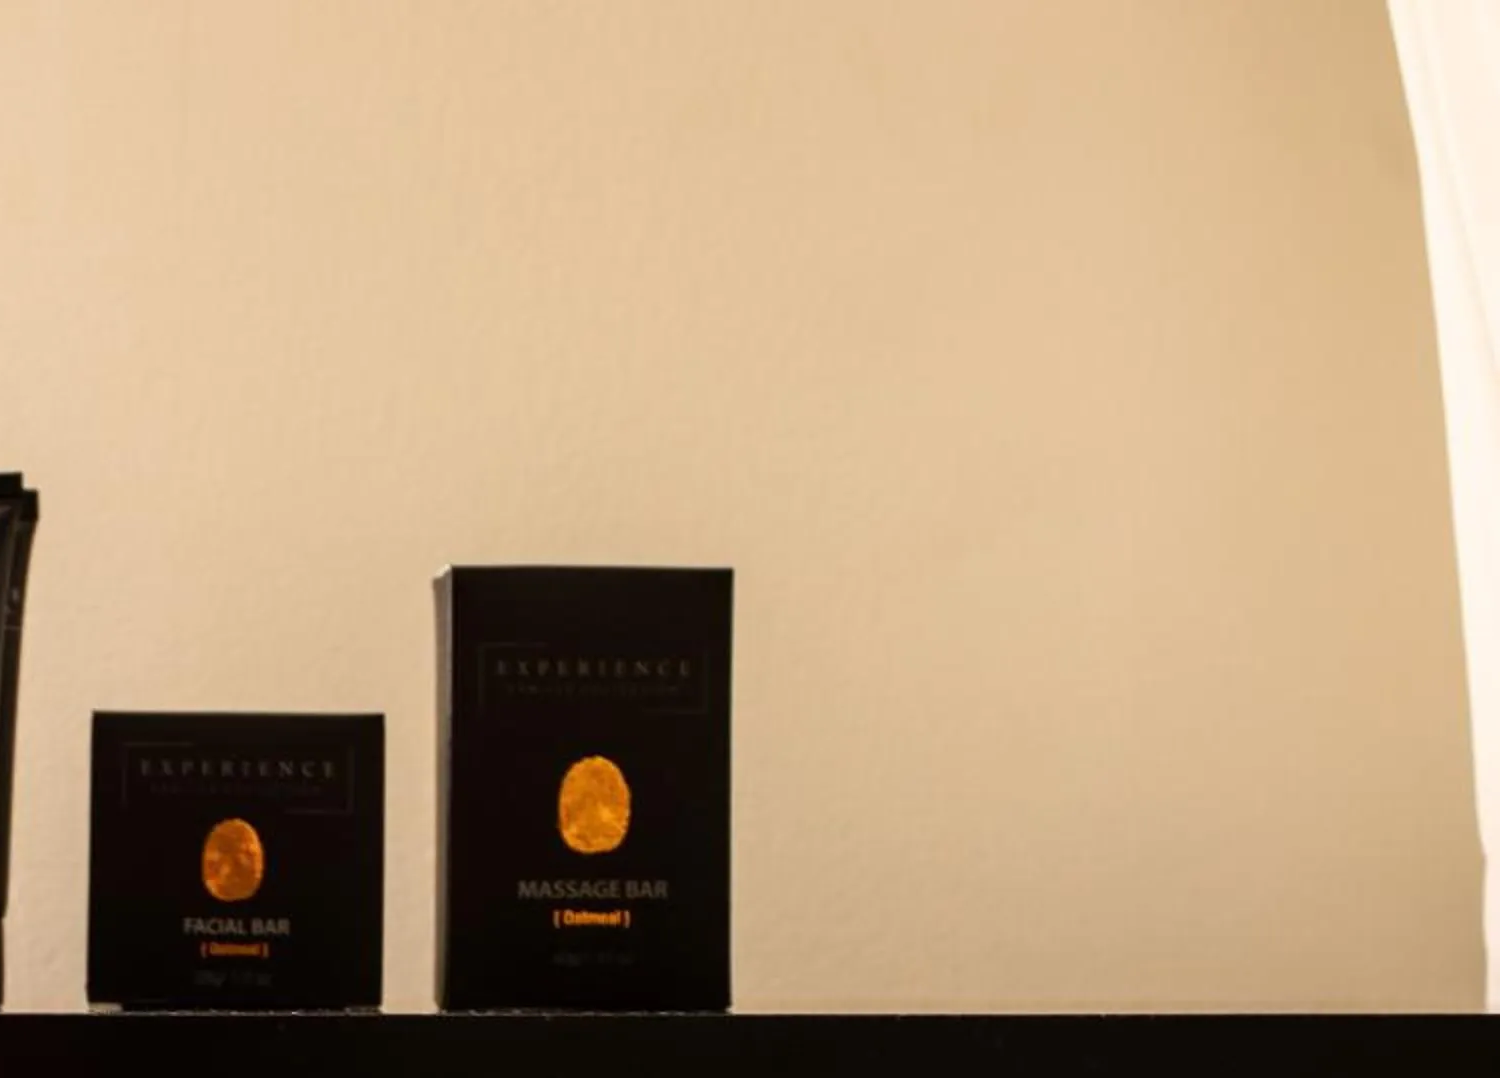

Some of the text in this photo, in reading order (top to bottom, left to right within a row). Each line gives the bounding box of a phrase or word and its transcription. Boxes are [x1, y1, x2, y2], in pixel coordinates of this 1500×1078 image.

[496, 659, 691, 679] EXPERIENCE
[139, 758, 337, 779] EXPERIENCE
[516, 879, 669, 900] MASSAGE BAR
[182, 917, 290, 935] FACIAL BAR
